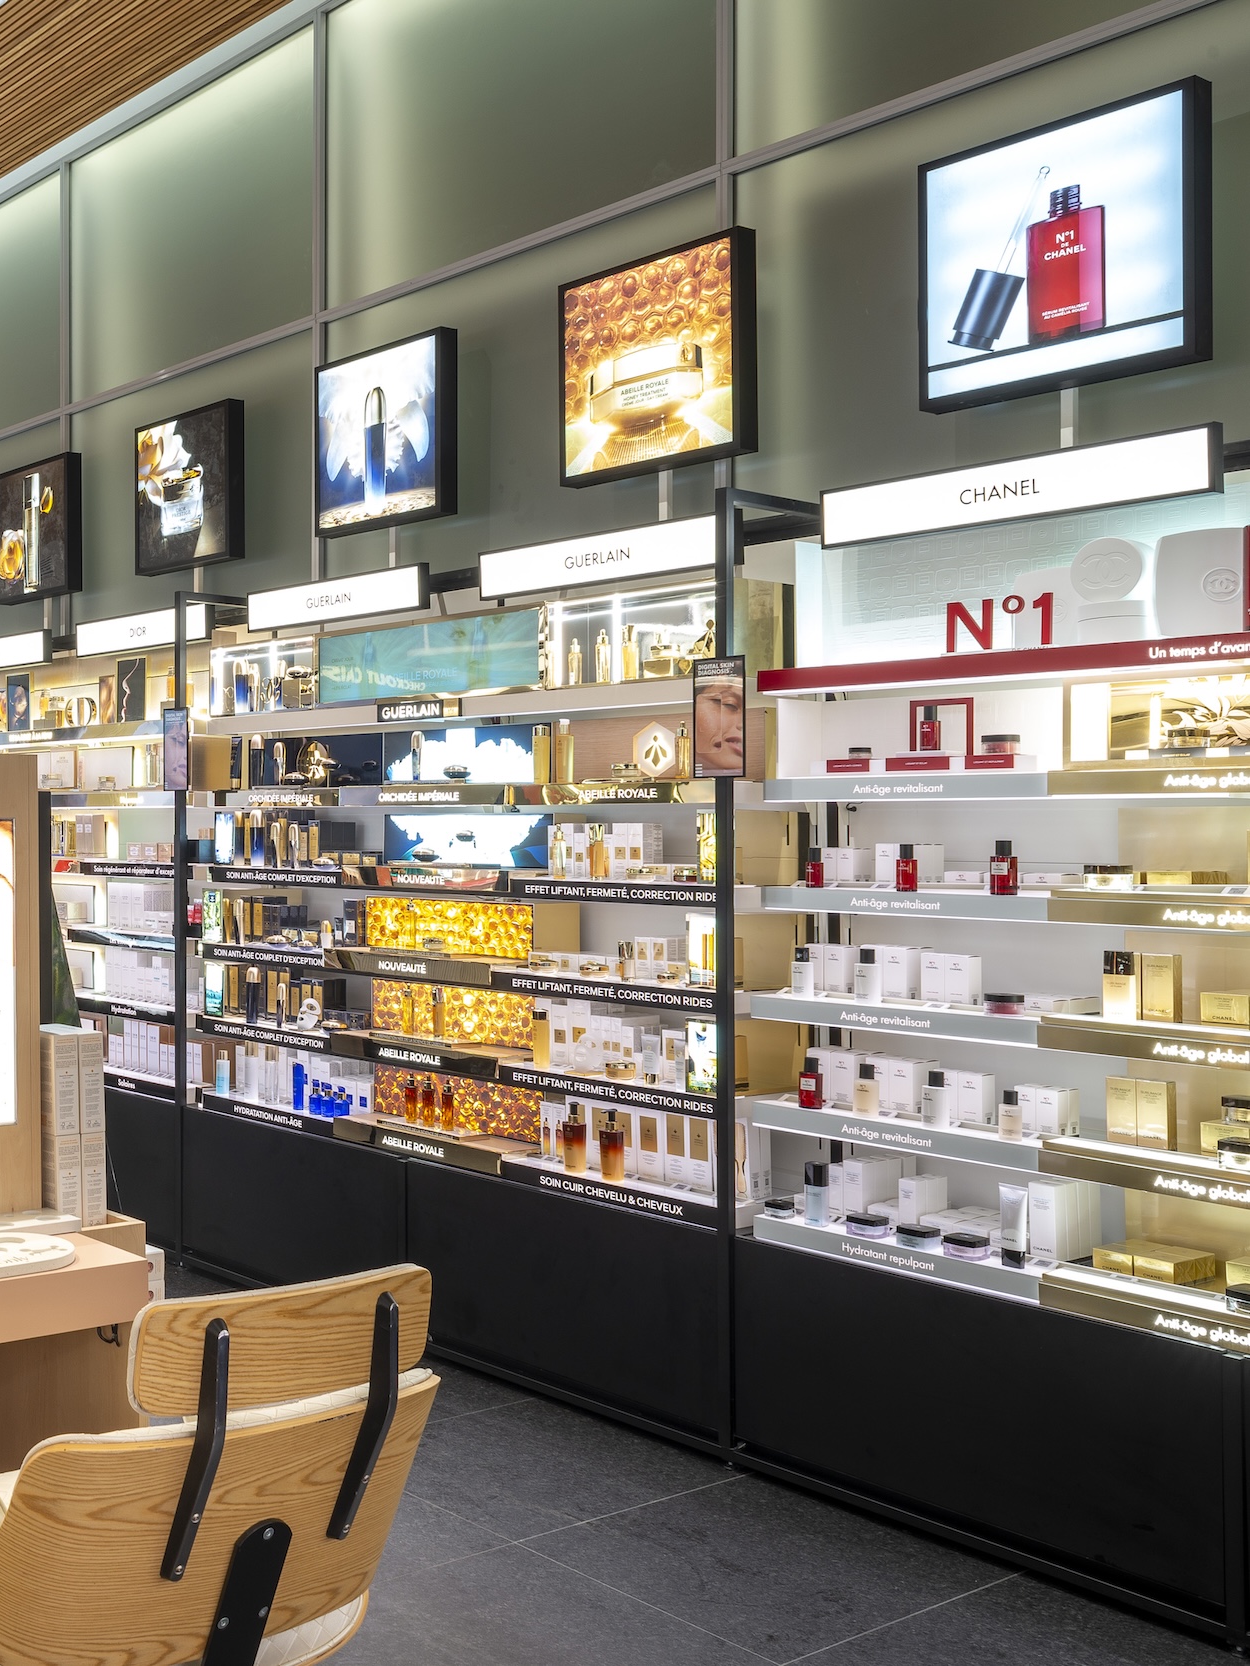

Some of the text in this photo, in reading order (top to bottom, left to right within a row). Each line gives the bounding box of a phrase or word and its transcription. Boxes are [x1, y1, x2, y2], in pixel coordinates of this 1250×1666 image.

[1056, 230, 1075, 244] N°1
[1044, 243, 1086, 261] CHANEL
[621, 378, 669, 396] ABEILLE ROYALE
[959, 478, 1040, 505] CHANEL
[564, 547, 630, 570] GUERLAIN
[306, 592, 351, 609] GUERLAIN
[946, 591, 1054, 654] N°1
[129, 626, 147, 638] DIOR
[1149, 646, 1166, 659] Un
[1169, 645, 1206, 659] temps
[698, 662, 719, 671] DIGITAL
[382, 703, 439, 720] GUERLAIN
[853, 782, 944, 796] Anti-âge revitalisant
[1164, 773, 1216, 788] Anti-âge
[248, 793, 313, 803] ORCHIDÉE IMPÉRIALE
[378, 790, 459, 802] ORCHIDÉE IMPÉRIALE
[579, 788, 657, 799] ABEILLE ROYALE
[226, 871, 336, 884] SOIN ANTI-ÂGE COMPLET D'EXCEPTION
[525, 885, 550, 895] EFFET
[551, 886, 586, 897] LIFTANT,
[586, 887, 629, 900] FERMETÉ,
[630, 889, 694, 902] CORRECTION
[850, 897, 941, 910] Anti-âge revitalisant
[1163, 908, 1215, 925] Anti-âge
[213, 948, 324, 967] SOIN ANTI-ÂGE COMPLET D'EXCEPTION
[378, 959, 426, 974] NOUVEAUTÉ
[512, 978, 713, 1008] EFFET LIFTANT, FERMETÉ, CORRECTION RIDES
[840, 1011, 931, 1029] Anti-âge revitalisant
[1212, 1014, 1236, 1022] CHANEL
[214, 1023, 324, 1049] SOIN ANTI-ÂGE COMPLET D'EXCEPTION
[378, 1047, 440, 1065] ABEILLE ROYALE
[1153, 1042, 1250, 1064] Anti-âge global
[512, 1072, 713, 1114] EFFET LIFTANT, FERMETÉ, CORRECTION RIDES
[233, 1104, 303, 1128] HYDRATATION ANTI-ÂGE
[841, 1124, 932, 1148] Anti-âge revitalisant
[382, 1135, 444, 1157] ABEILLE ROYALE
[1154, 1175, 1206, 1196] Anti-âge
[539, 1176, 683, 1216] SOIN CUIR CHEVELU & CHEVEUX
[842, 1241, 935, 1272] Hydratant repulpant
[1033, 1245, 1053, 1253] CHANEL
[1102, 1265, 1122, 1273] CHANEL
[1143, 1273, 1164, 1281] CHANEL
[1154, 1314, 1207, 1337] Anti-âge
